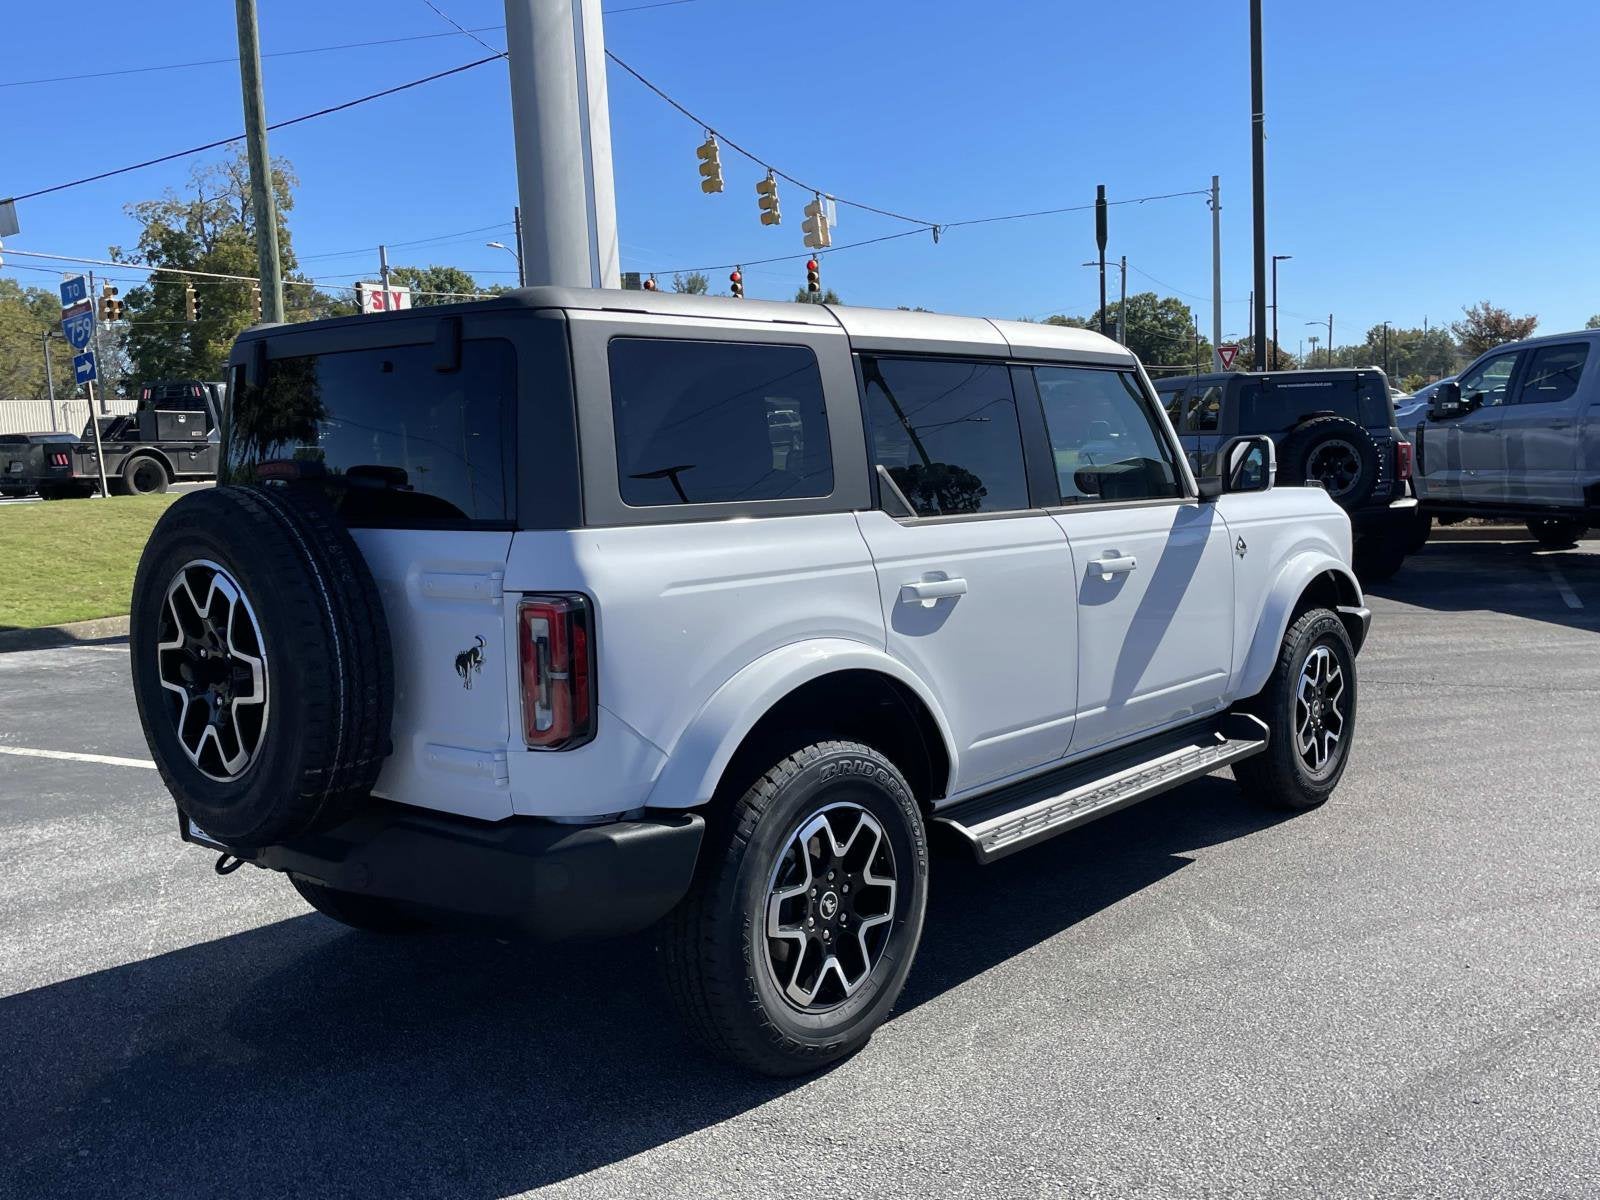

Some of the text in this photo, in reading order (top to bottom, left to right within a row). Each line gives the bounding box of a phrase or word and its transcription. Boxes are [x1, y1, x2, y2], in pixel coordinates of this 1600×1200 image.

[67, 284, 80, 299] TO
[372, 290, 402, 311] SY
[68, 318, 91, 344] 759
